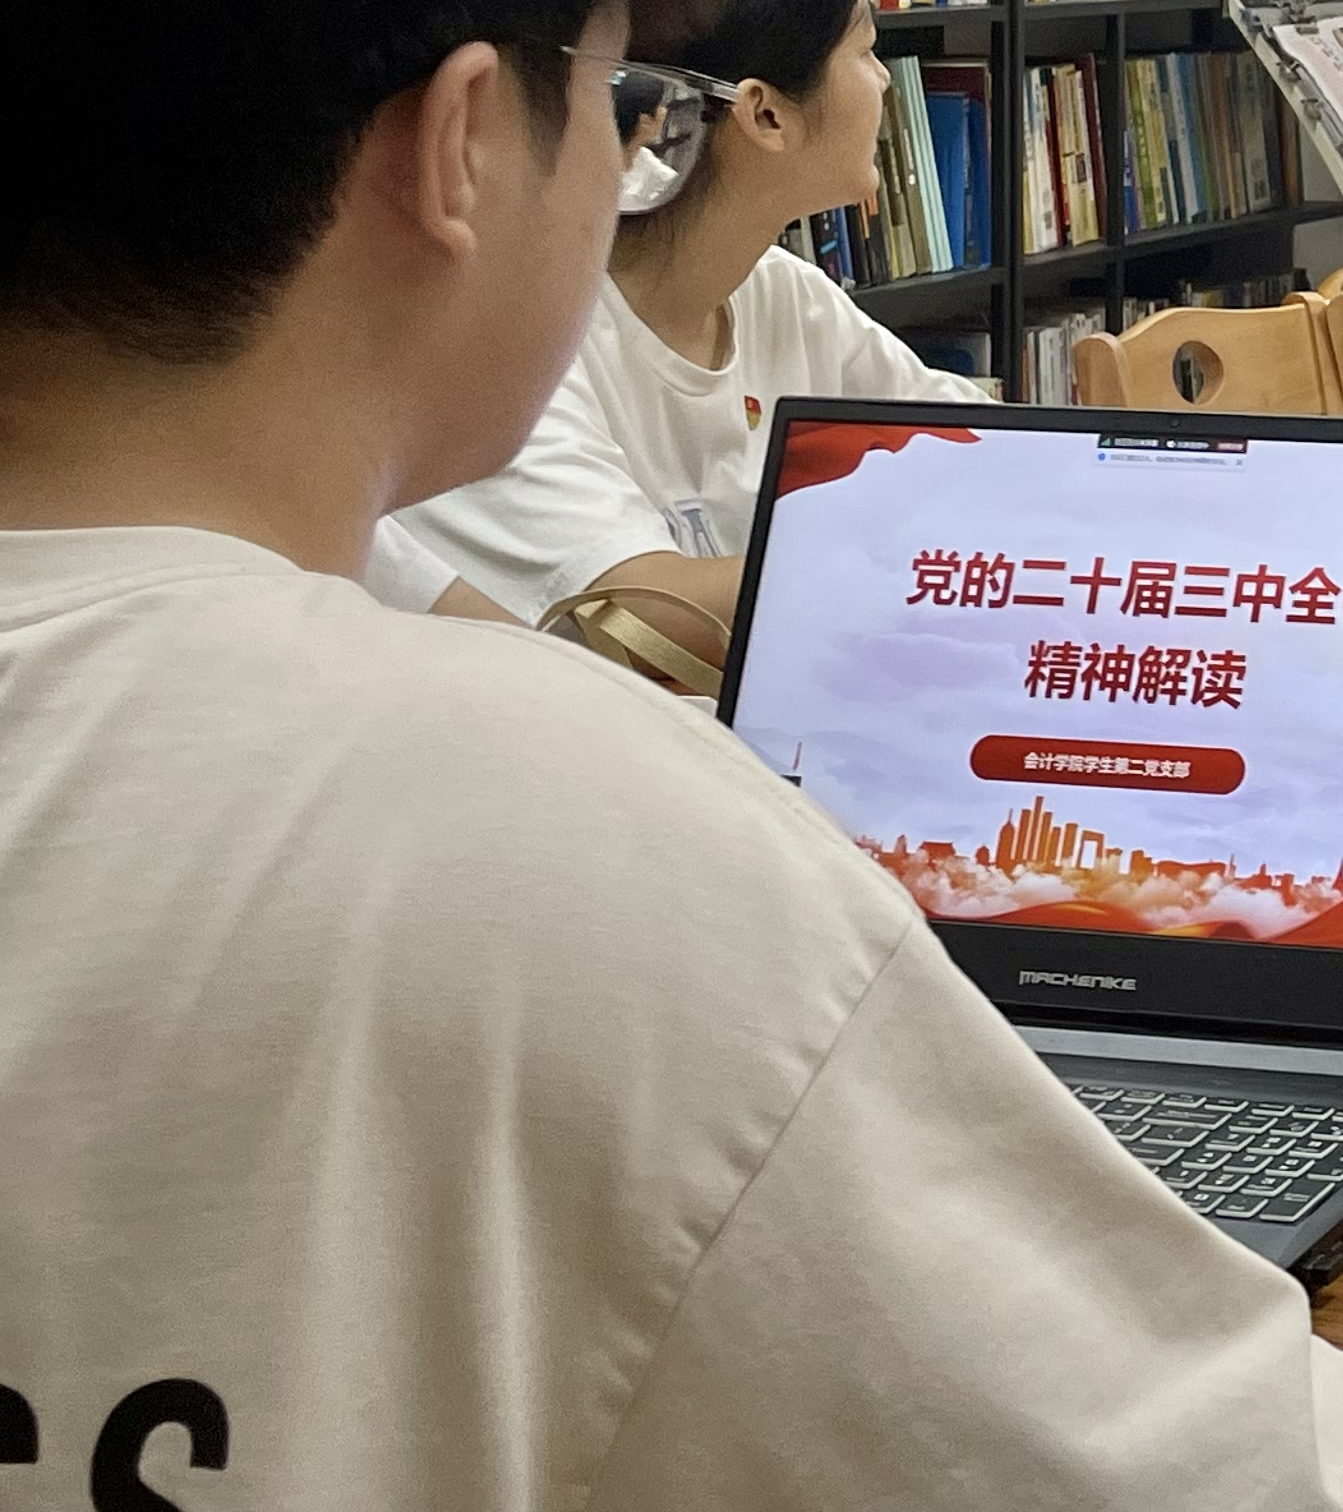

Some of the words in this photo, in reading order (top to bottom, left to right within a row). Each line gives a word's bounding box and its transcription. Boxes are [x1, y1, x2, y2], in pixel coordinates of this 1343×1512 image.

[1025, 640, 1246, 709] 精神解读
[1023, 750, 1191, 780] 会计学院学生第二党支部
[1018, 970, 1137, 991] MACHENIKE
